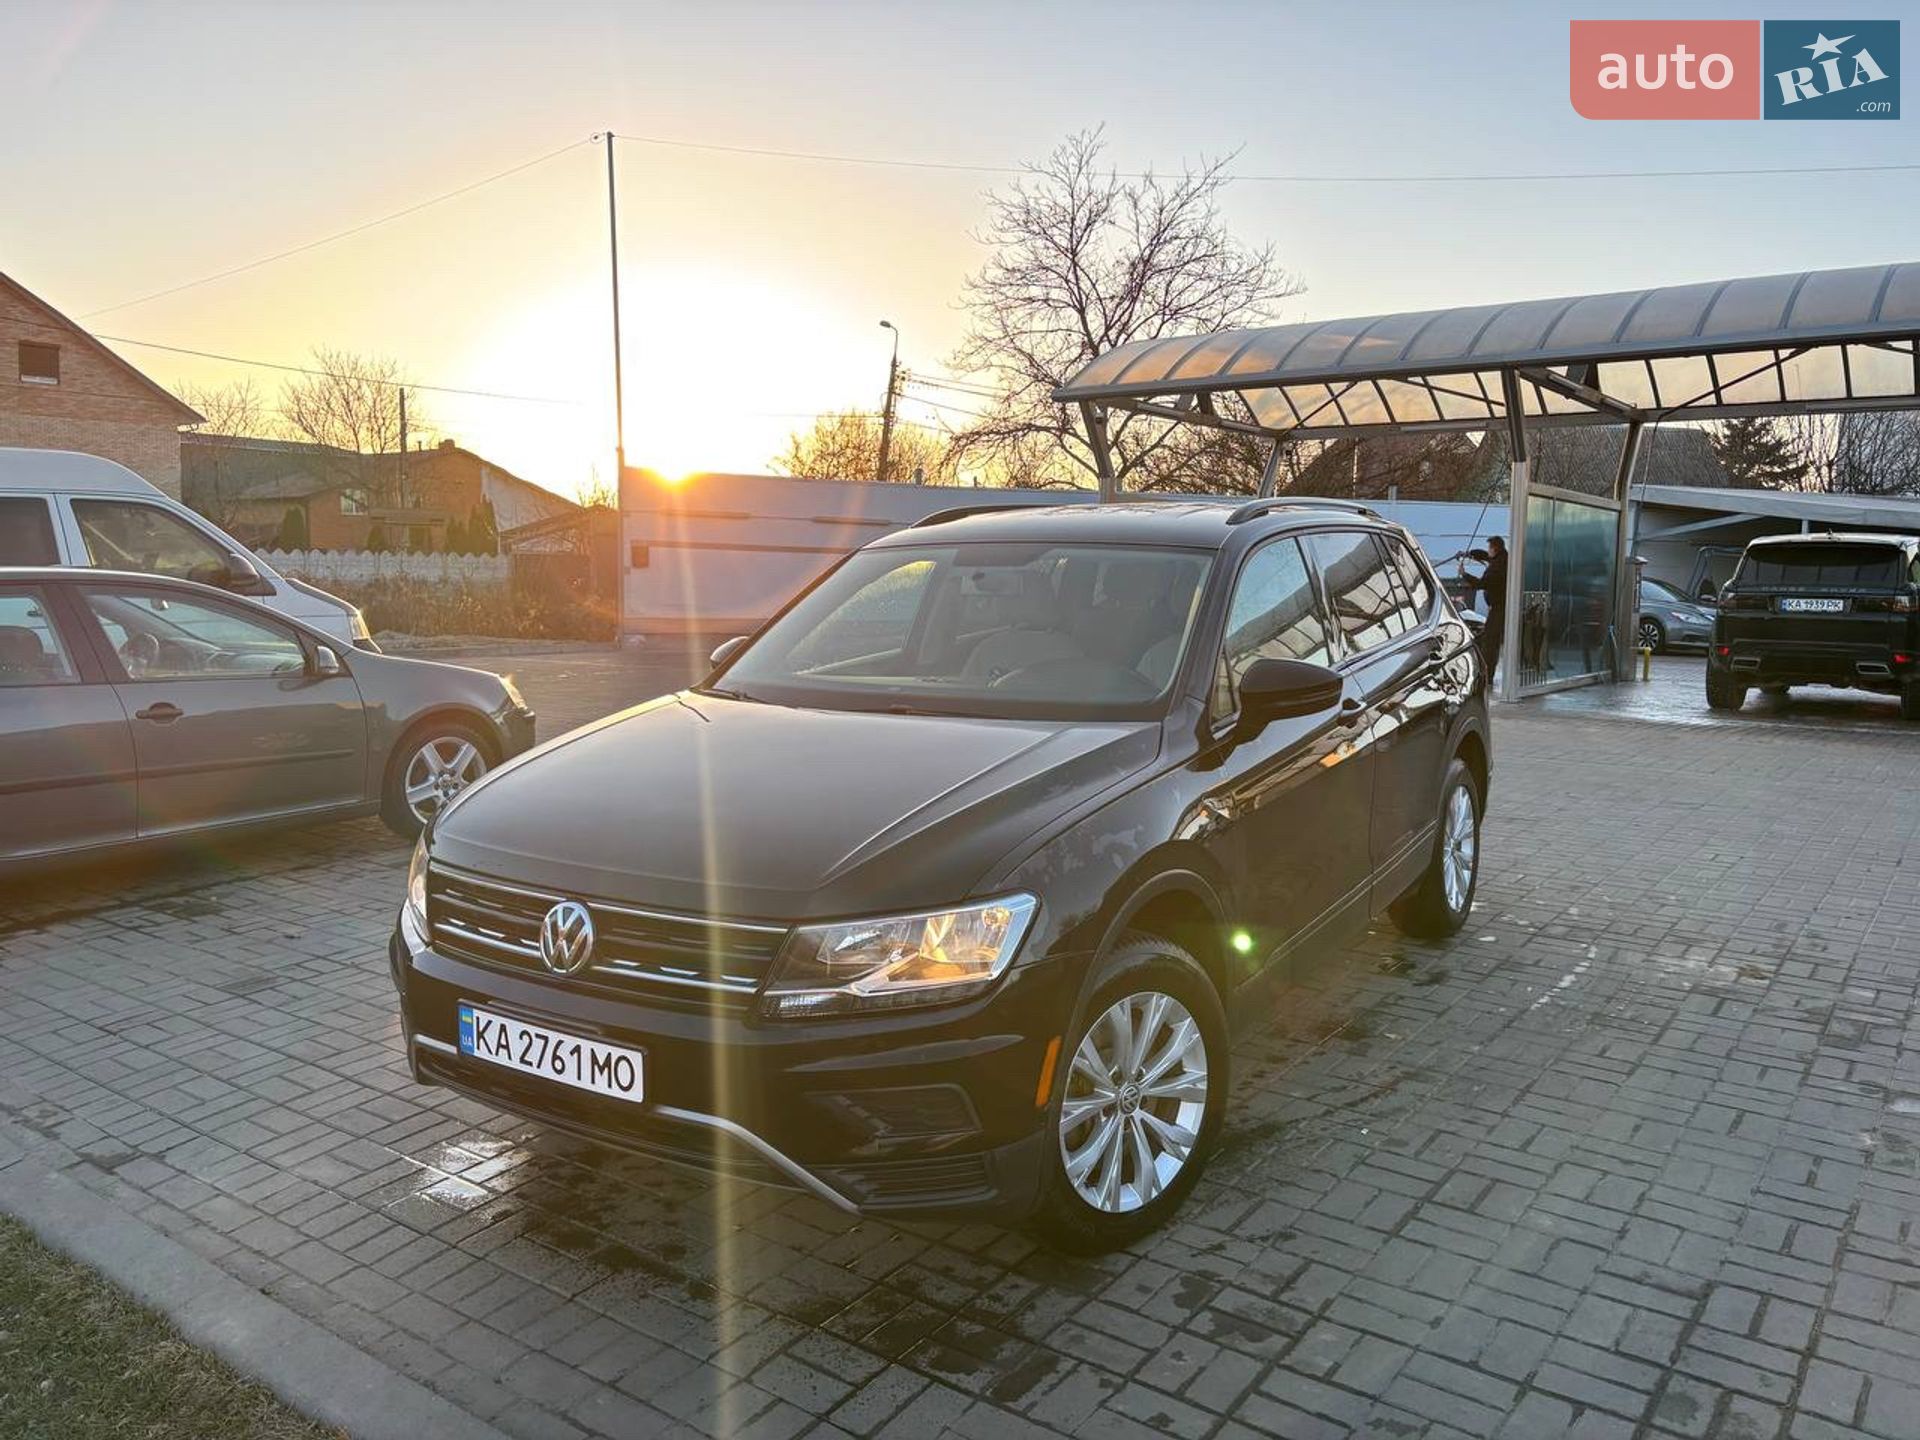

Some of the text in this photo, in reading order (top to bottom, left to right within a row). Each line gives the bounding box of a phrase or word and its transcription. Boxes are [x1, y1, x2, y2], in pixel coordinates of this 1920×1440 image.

[1787, 600, 1801, 610] KA
[475, 1015, 636, 1093] KA 2761 MO
